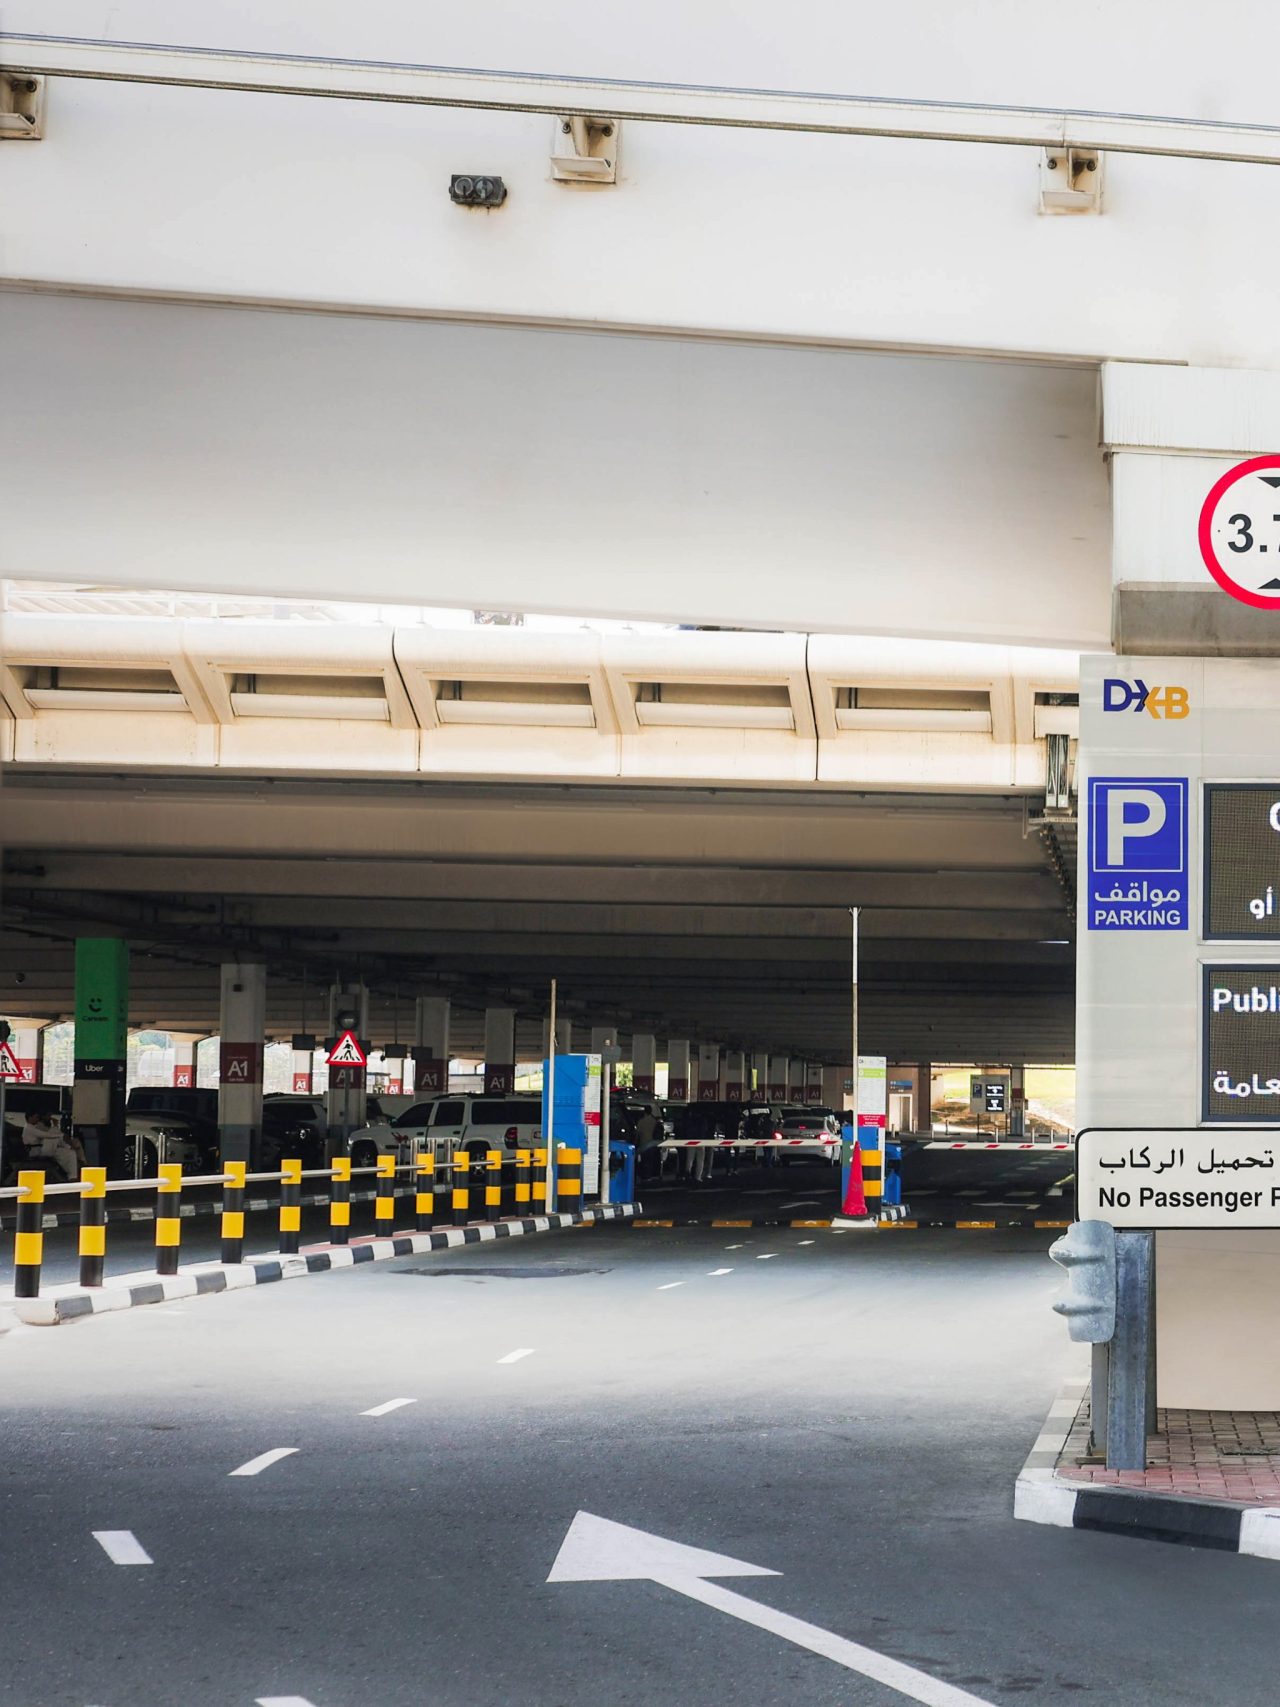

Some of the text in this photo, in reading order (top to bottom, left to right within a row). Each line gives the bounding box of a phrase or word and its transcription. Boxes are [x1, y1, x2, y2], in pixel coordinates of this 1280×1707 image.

[1104, 679, 1189, 719] DXB
[1107, 789, 1166, 866] P
[1094, 881, 1181, 906] مواقف
[1094, 909, 1181, 926] PARKING
[228, 1060, 249, 1077] A1
[177, 1075, 189, 1084] A1
[296, 1080, 306, 1089] A1
[421, 1073, 438, 1085] A1
[490, 1077, 505, 1088] A1
[672, 1088, 683, 1096] A1
[703, 1088, 713, 1097] A1
[730, 1090, 740, 1098] A1
[753, 1091, 763, 1099] A1
[774, 1089, 784, 1098] A1
[1099, 1145, 1185, 1174] الركاب
[1197, 1149, 1275, 1174] تحميل
[1099, 1187, 1131, 1208] No
[1140, 1187, 1263, 1213] Passenger
